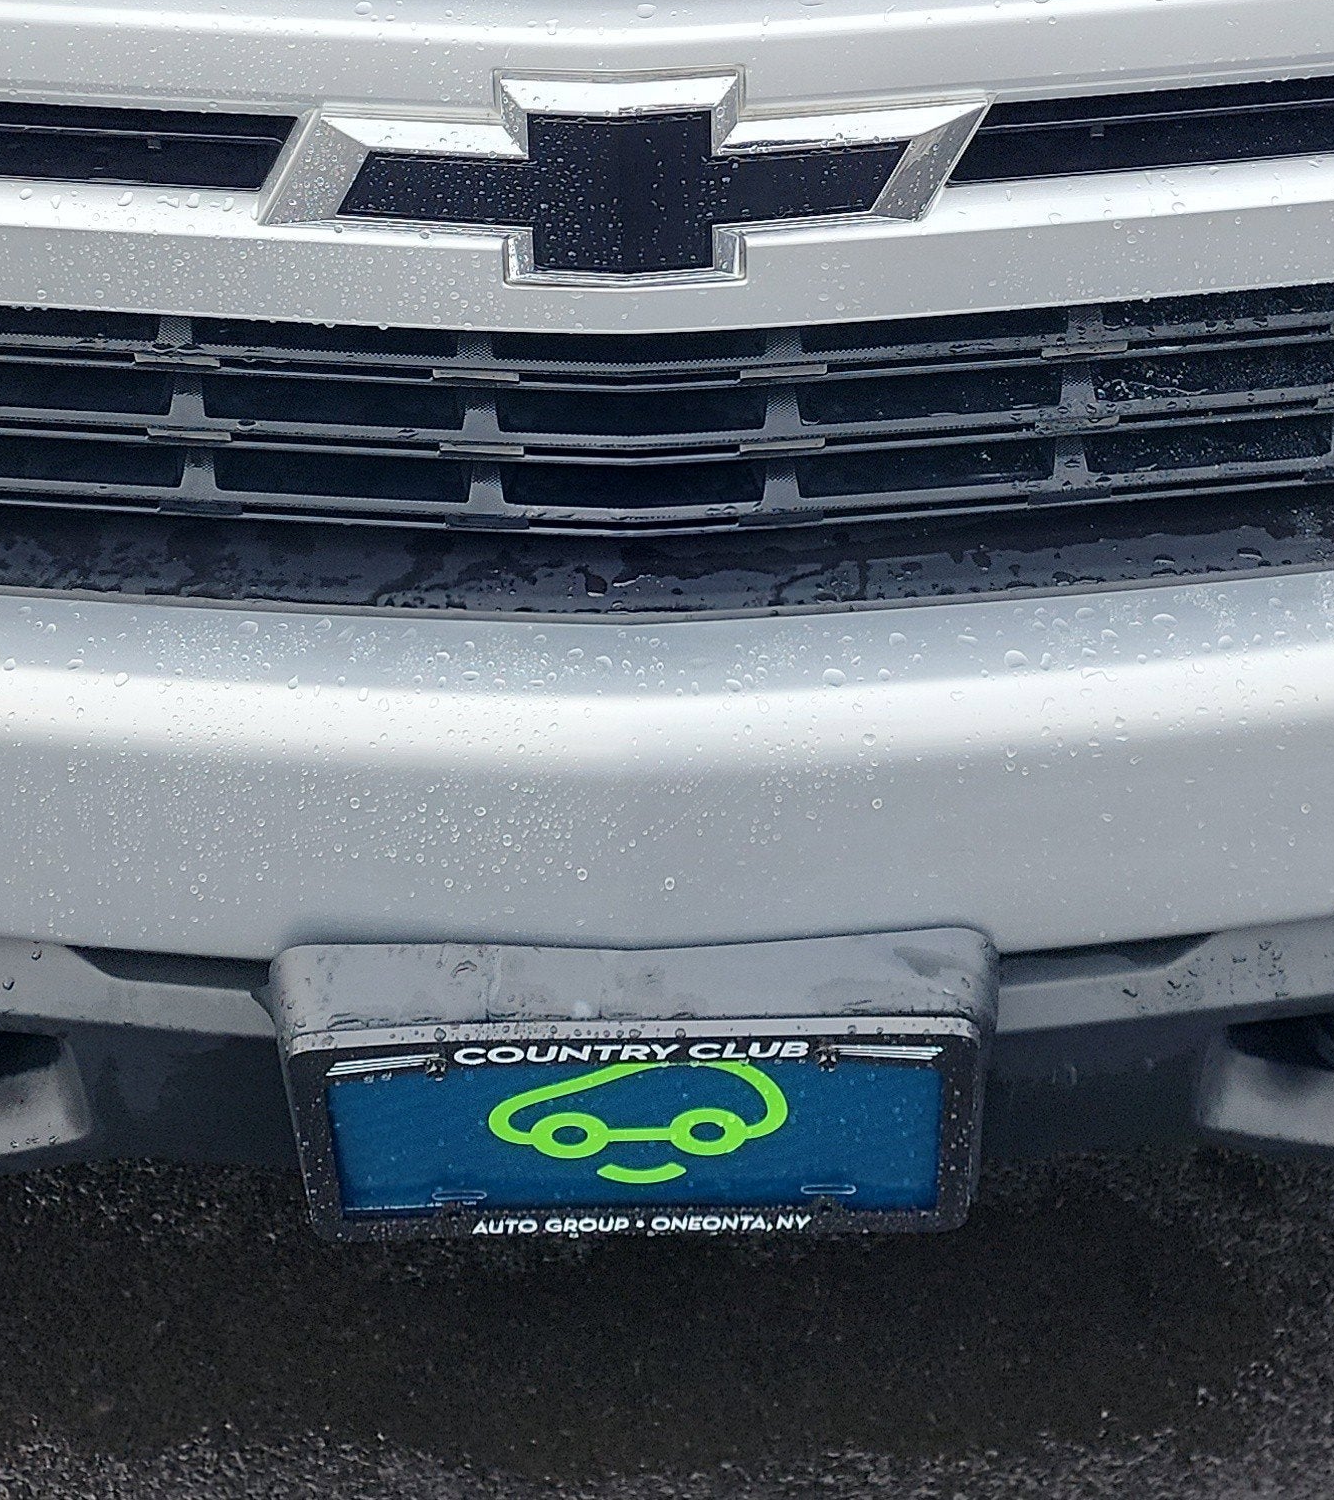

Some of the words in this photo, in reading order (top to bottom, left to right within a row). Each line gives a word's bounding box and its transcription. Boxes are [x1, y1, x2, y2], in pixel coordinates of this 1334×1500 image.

[453, 1043, 679, 1064] COUNTRY
[687, 1041, 810, 1061] CLUB
[472, 1217, 539, 1236] AUTO
[544, 1217, 630, 1234] GROUP
